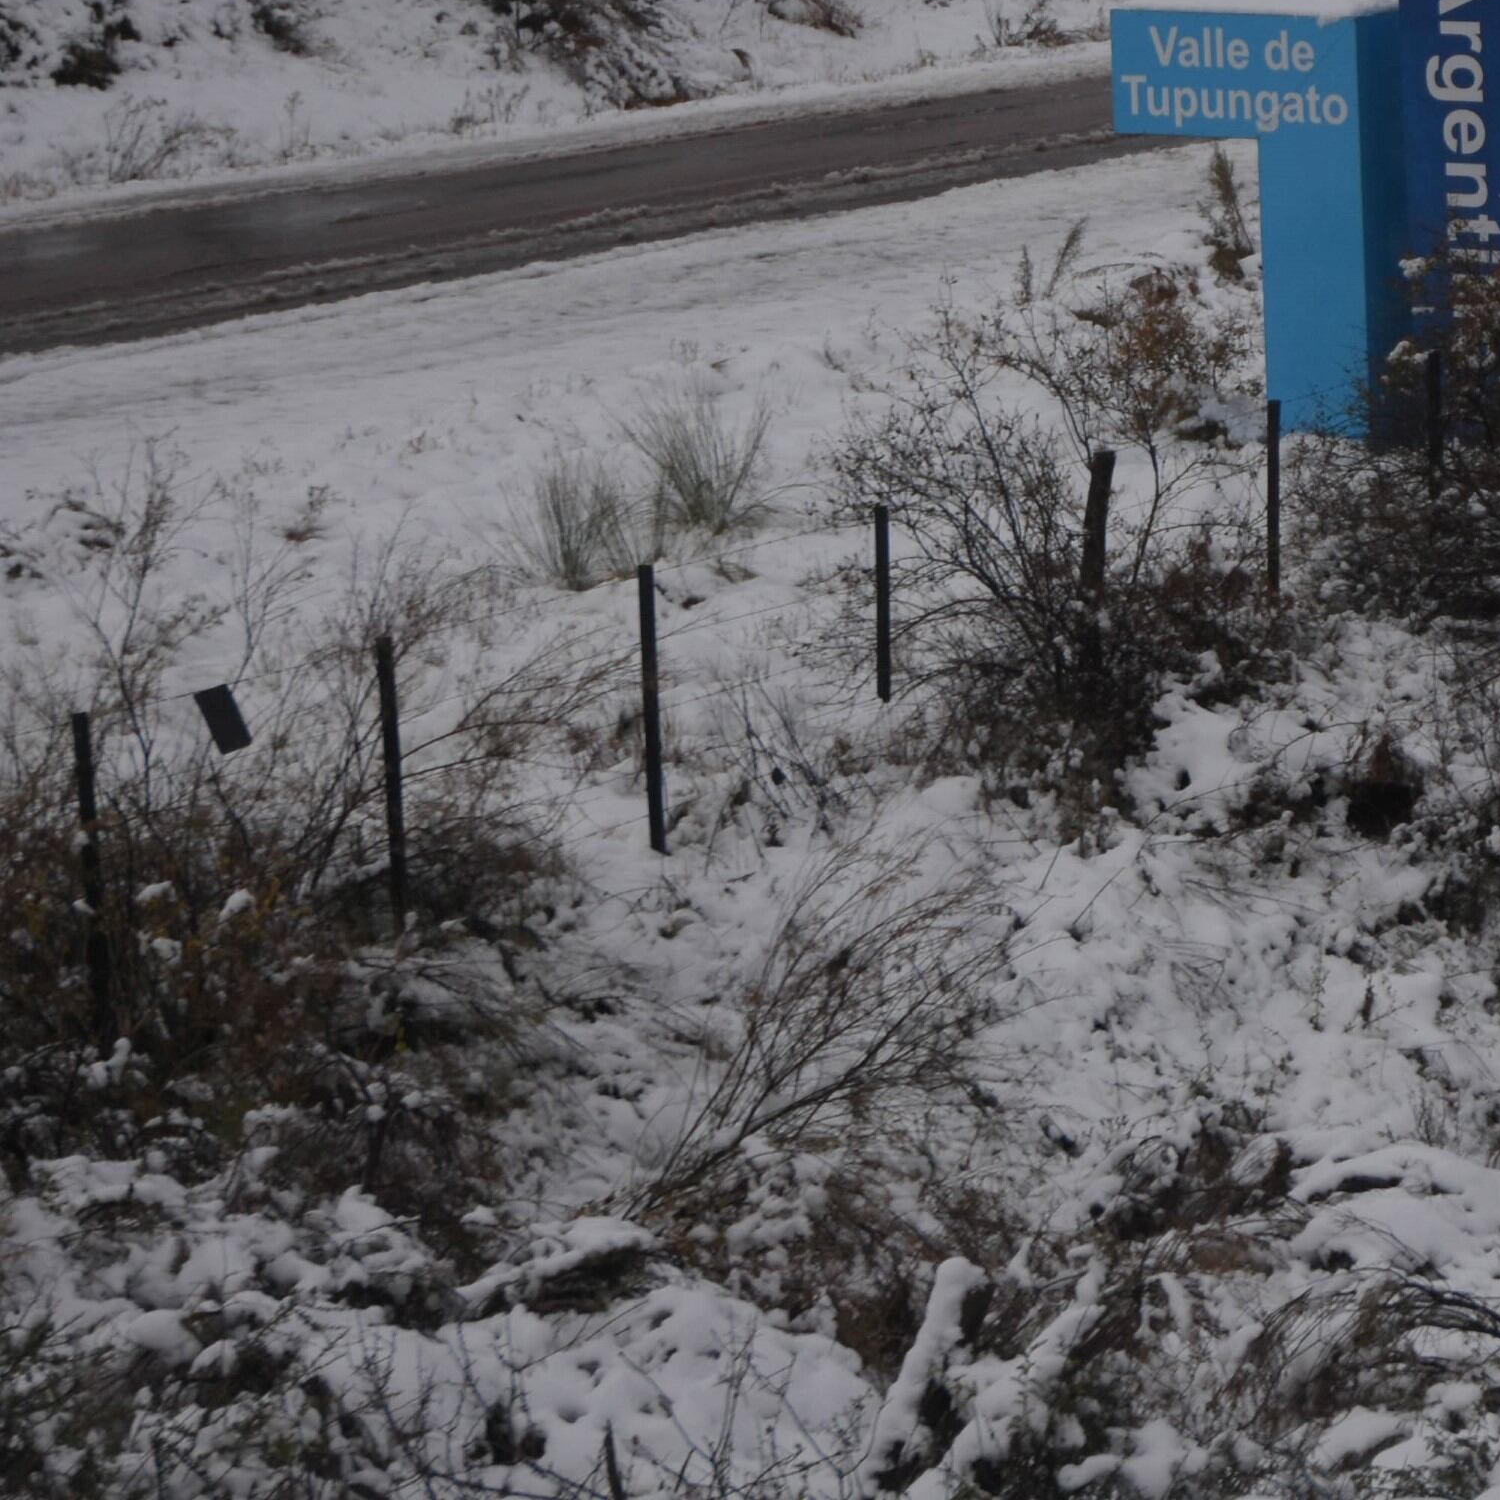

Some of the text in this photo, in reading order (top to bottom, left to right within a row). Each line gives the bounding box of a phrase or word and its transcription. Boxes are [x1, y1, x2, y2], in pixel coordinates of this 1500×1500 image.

[1149, 26, 1315, 71] Valle de
[1121, 74, 1348, 132] Tupungato
